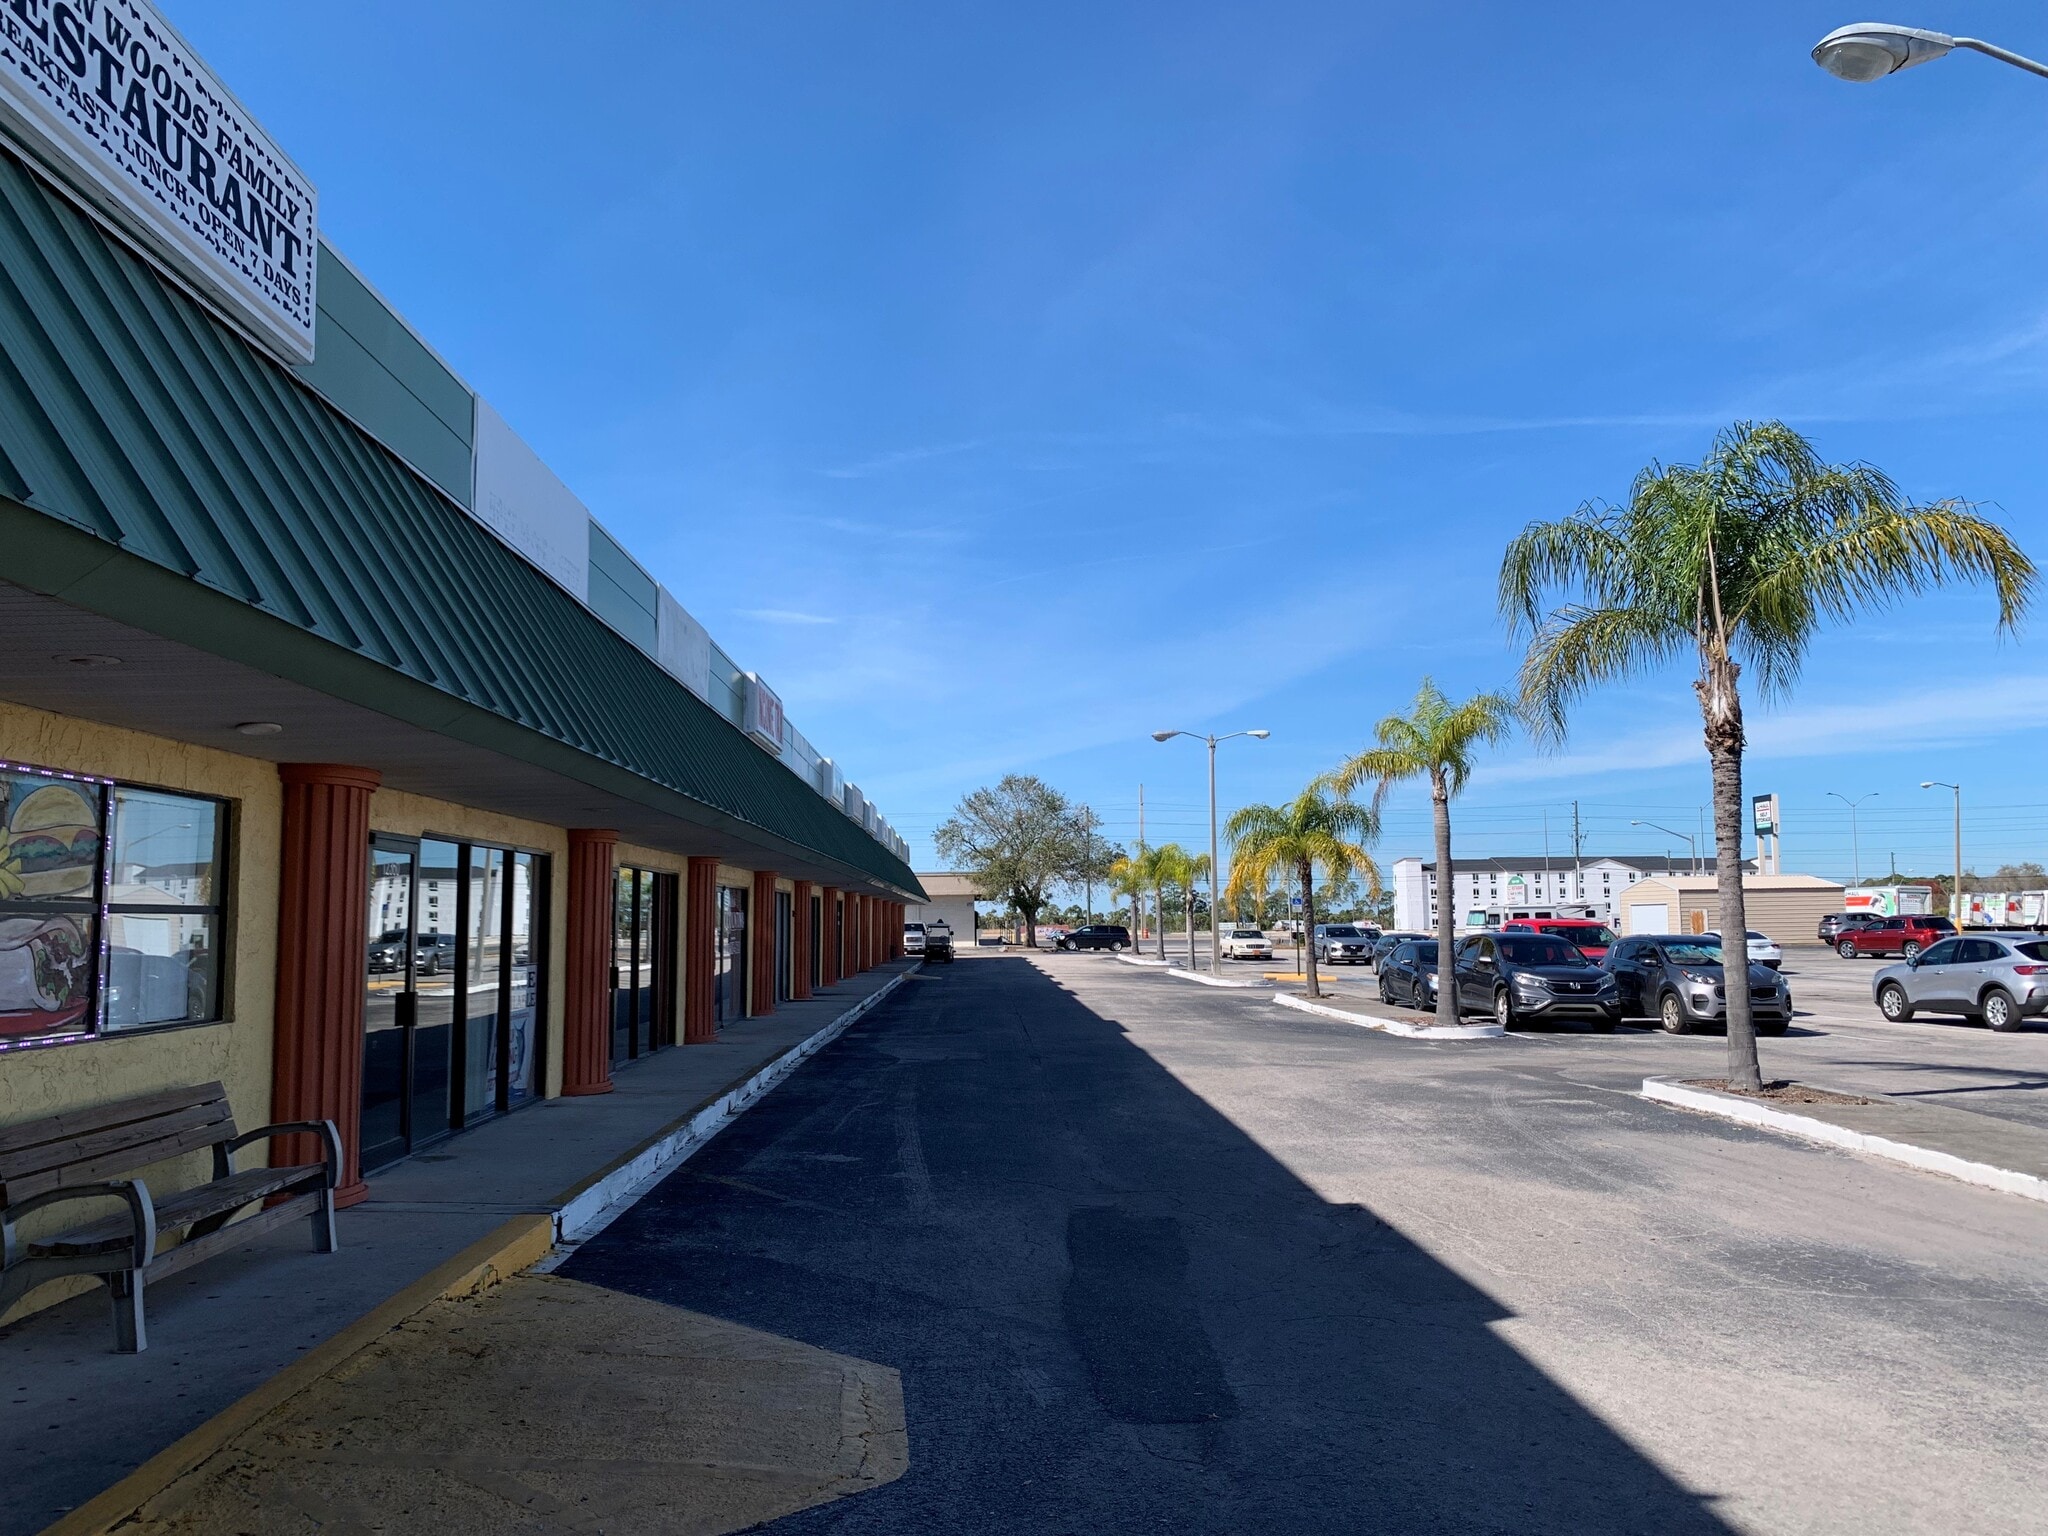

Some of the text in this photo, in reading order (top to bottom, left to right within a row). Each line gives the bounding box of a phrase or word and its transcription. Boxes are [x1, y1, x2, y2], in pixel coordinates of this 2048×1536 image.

[1, 0, 302, 280] ESTAURANT
[103, 5, 209, 140] WOODS
[214, 124, 301, 230] FAMILY
[121, 127, 189, 207] LUNCH
[198, 202, 245, 259] OPEN
[250, 249, 259, 268] 7
[262, 259, 301, 306] DAYS
